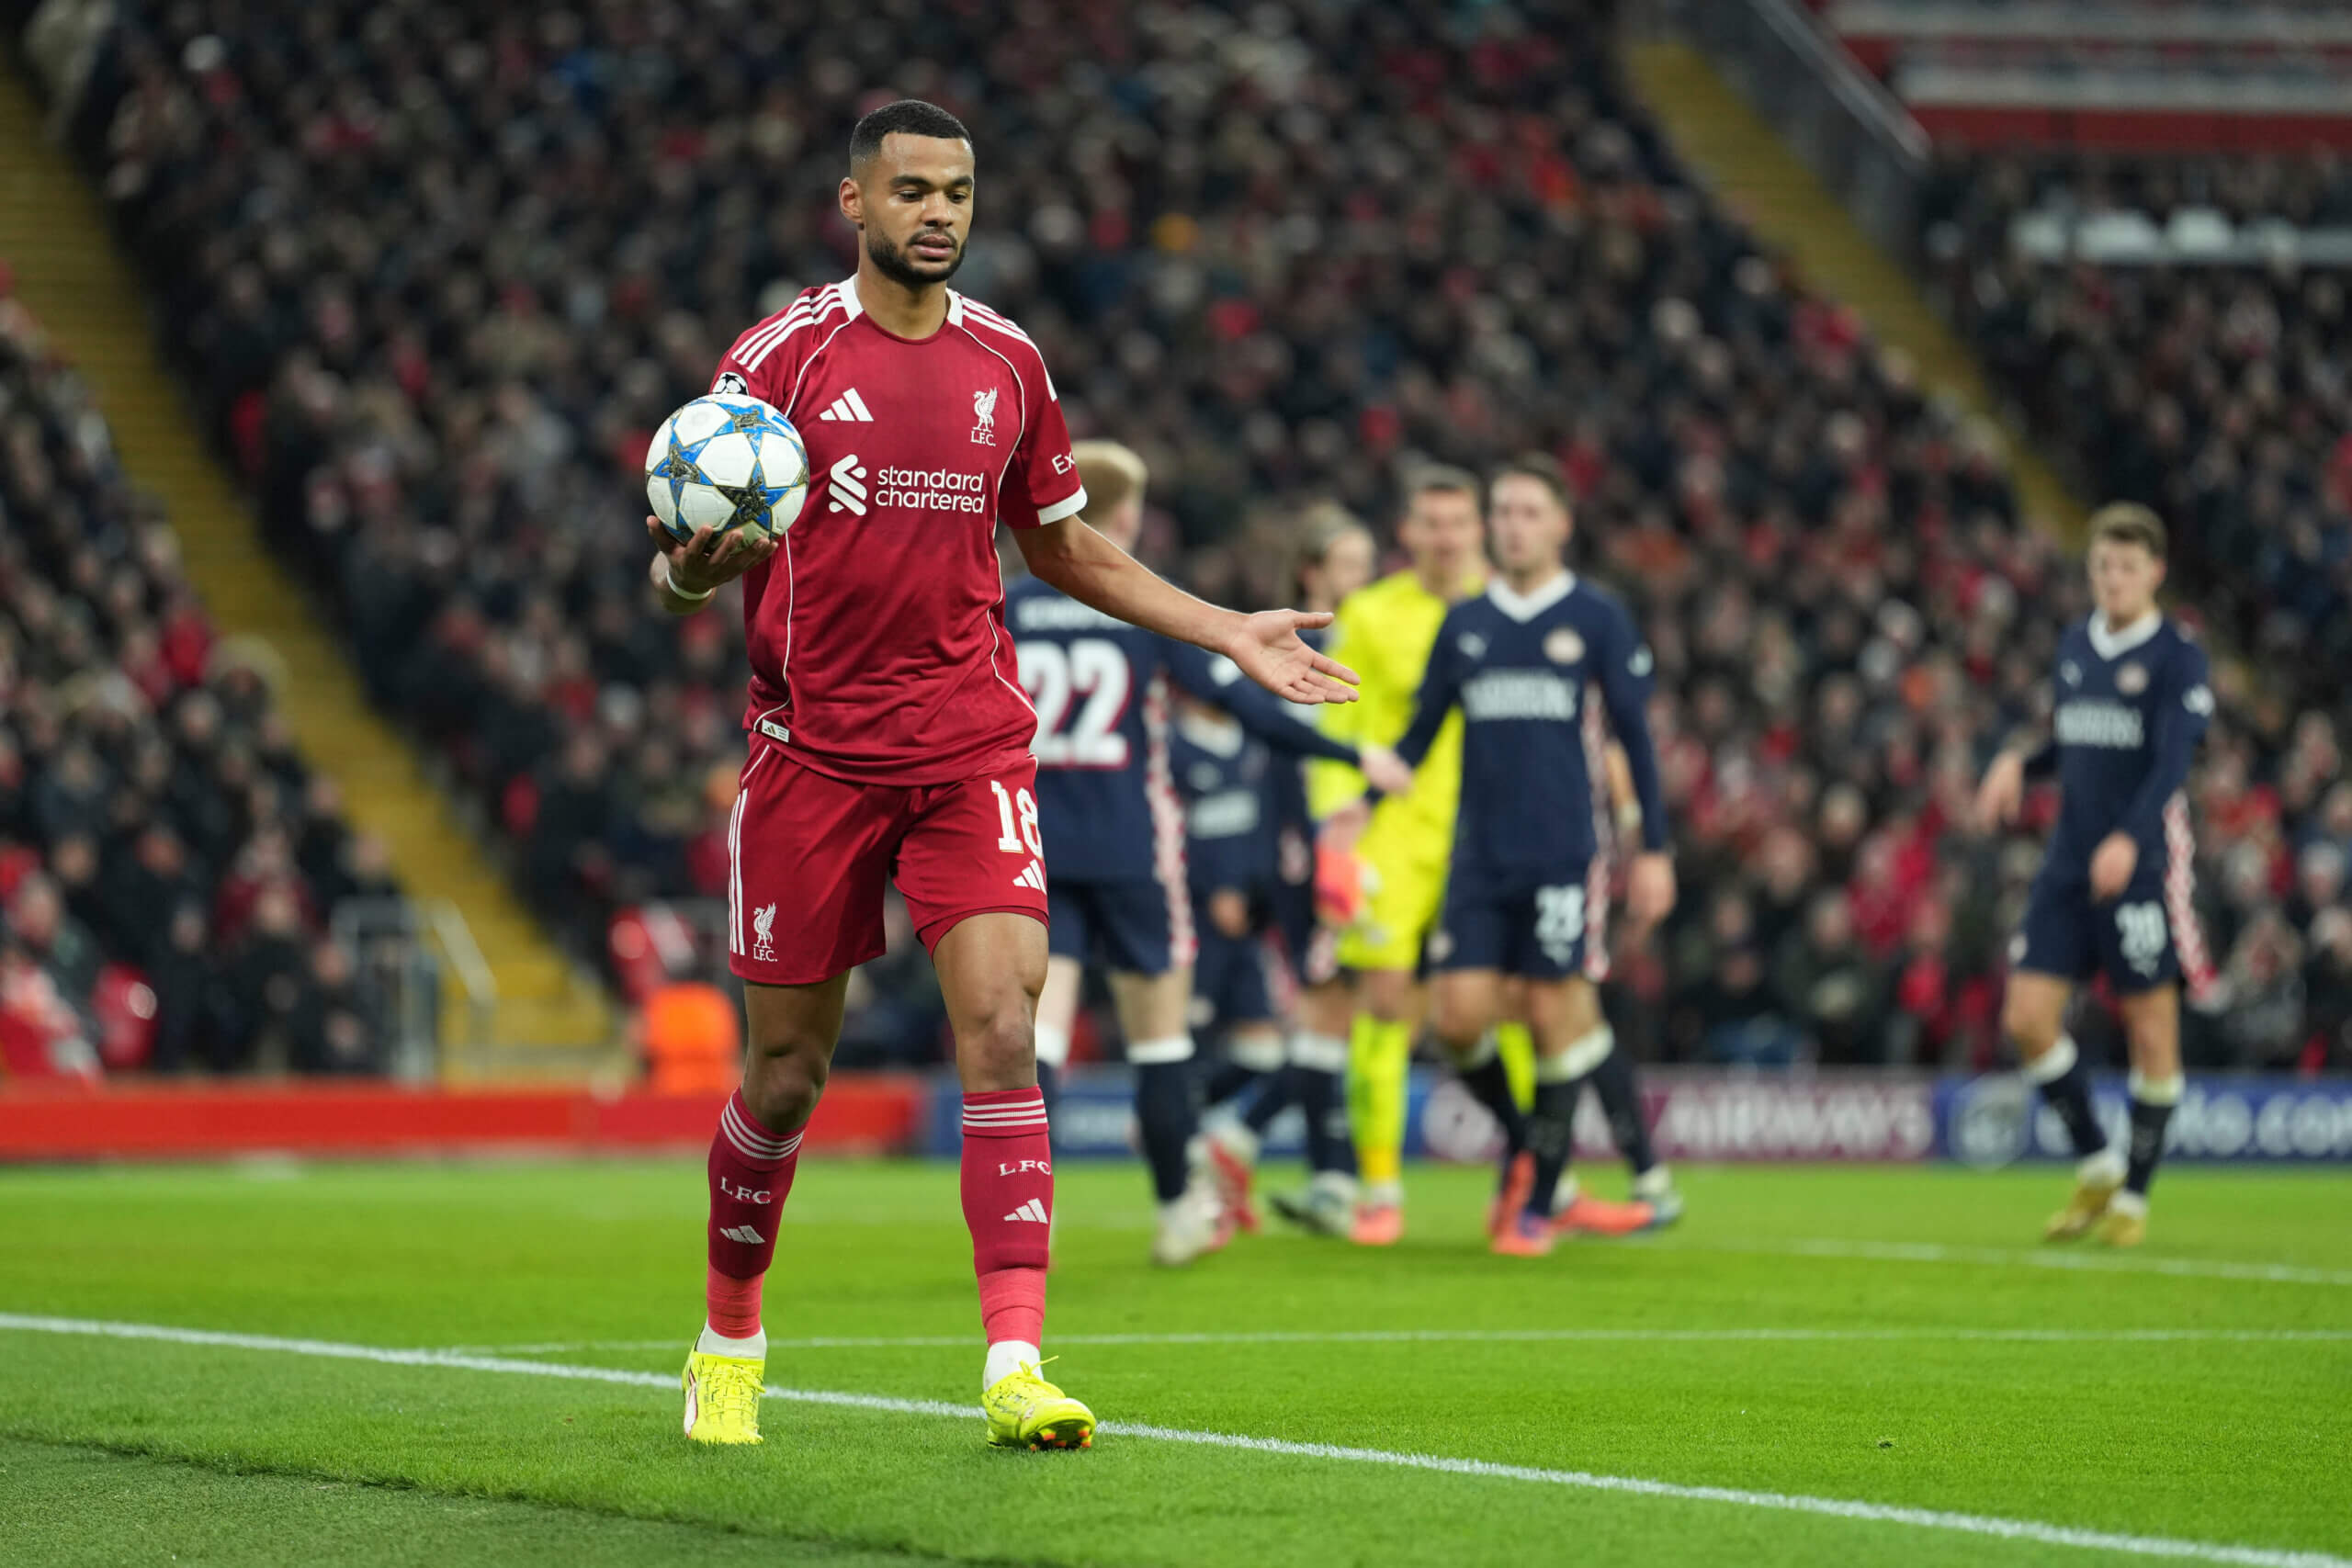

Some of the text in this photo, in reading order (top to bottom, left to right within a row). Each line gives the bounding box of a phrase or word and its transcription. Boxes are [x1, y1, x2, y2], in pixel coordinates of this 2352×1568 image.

[876, 465, 984, 492] standard
[875, 486, 986, 513] chartered
[1016, 638, 1132, 770] 22
[990, 779, 1044, 860] 18
[999, 1160, 1051, 1177] LFC
[719, 1176, 771, 1205] LFC
